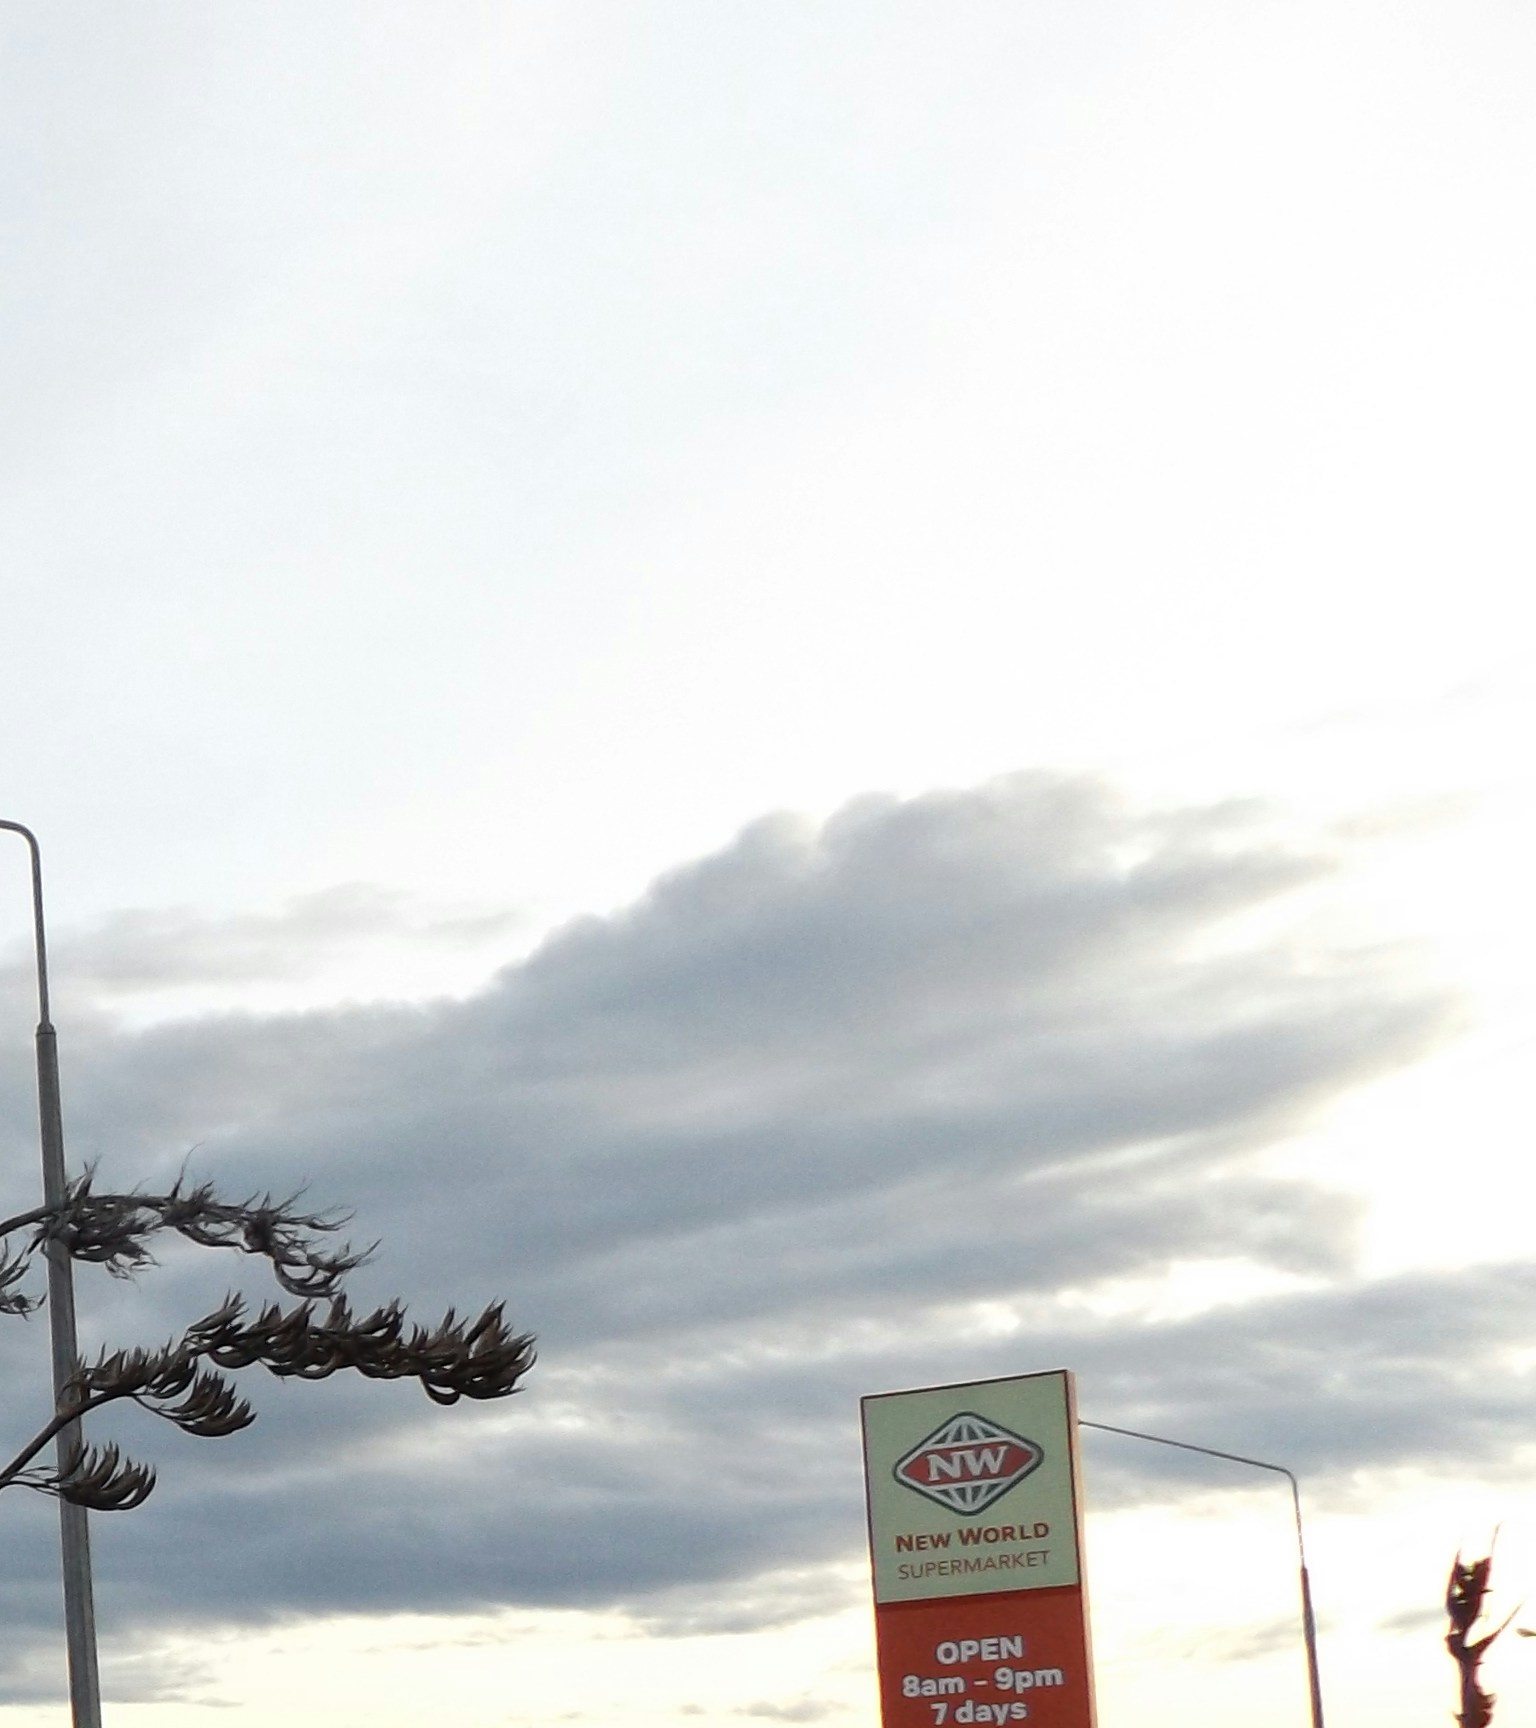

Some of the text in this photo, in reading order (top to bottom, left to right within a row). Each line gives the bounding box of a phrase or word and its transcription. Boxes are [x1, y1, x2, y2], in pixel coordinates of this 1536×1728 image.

[926, 1445, 1009, 1482] NW
[895, 1522, 1050, 1552] NEW WORLD
[897, 1549, 1052, 1580] SUPERMARKET
[936, 1635, 1024, 1665] OPEN
[902, 1674, 966, 1698] 8am
[994, 1666, 1064, 1695] 9pm
[930, 1700, 1028, 1727] 7 days
